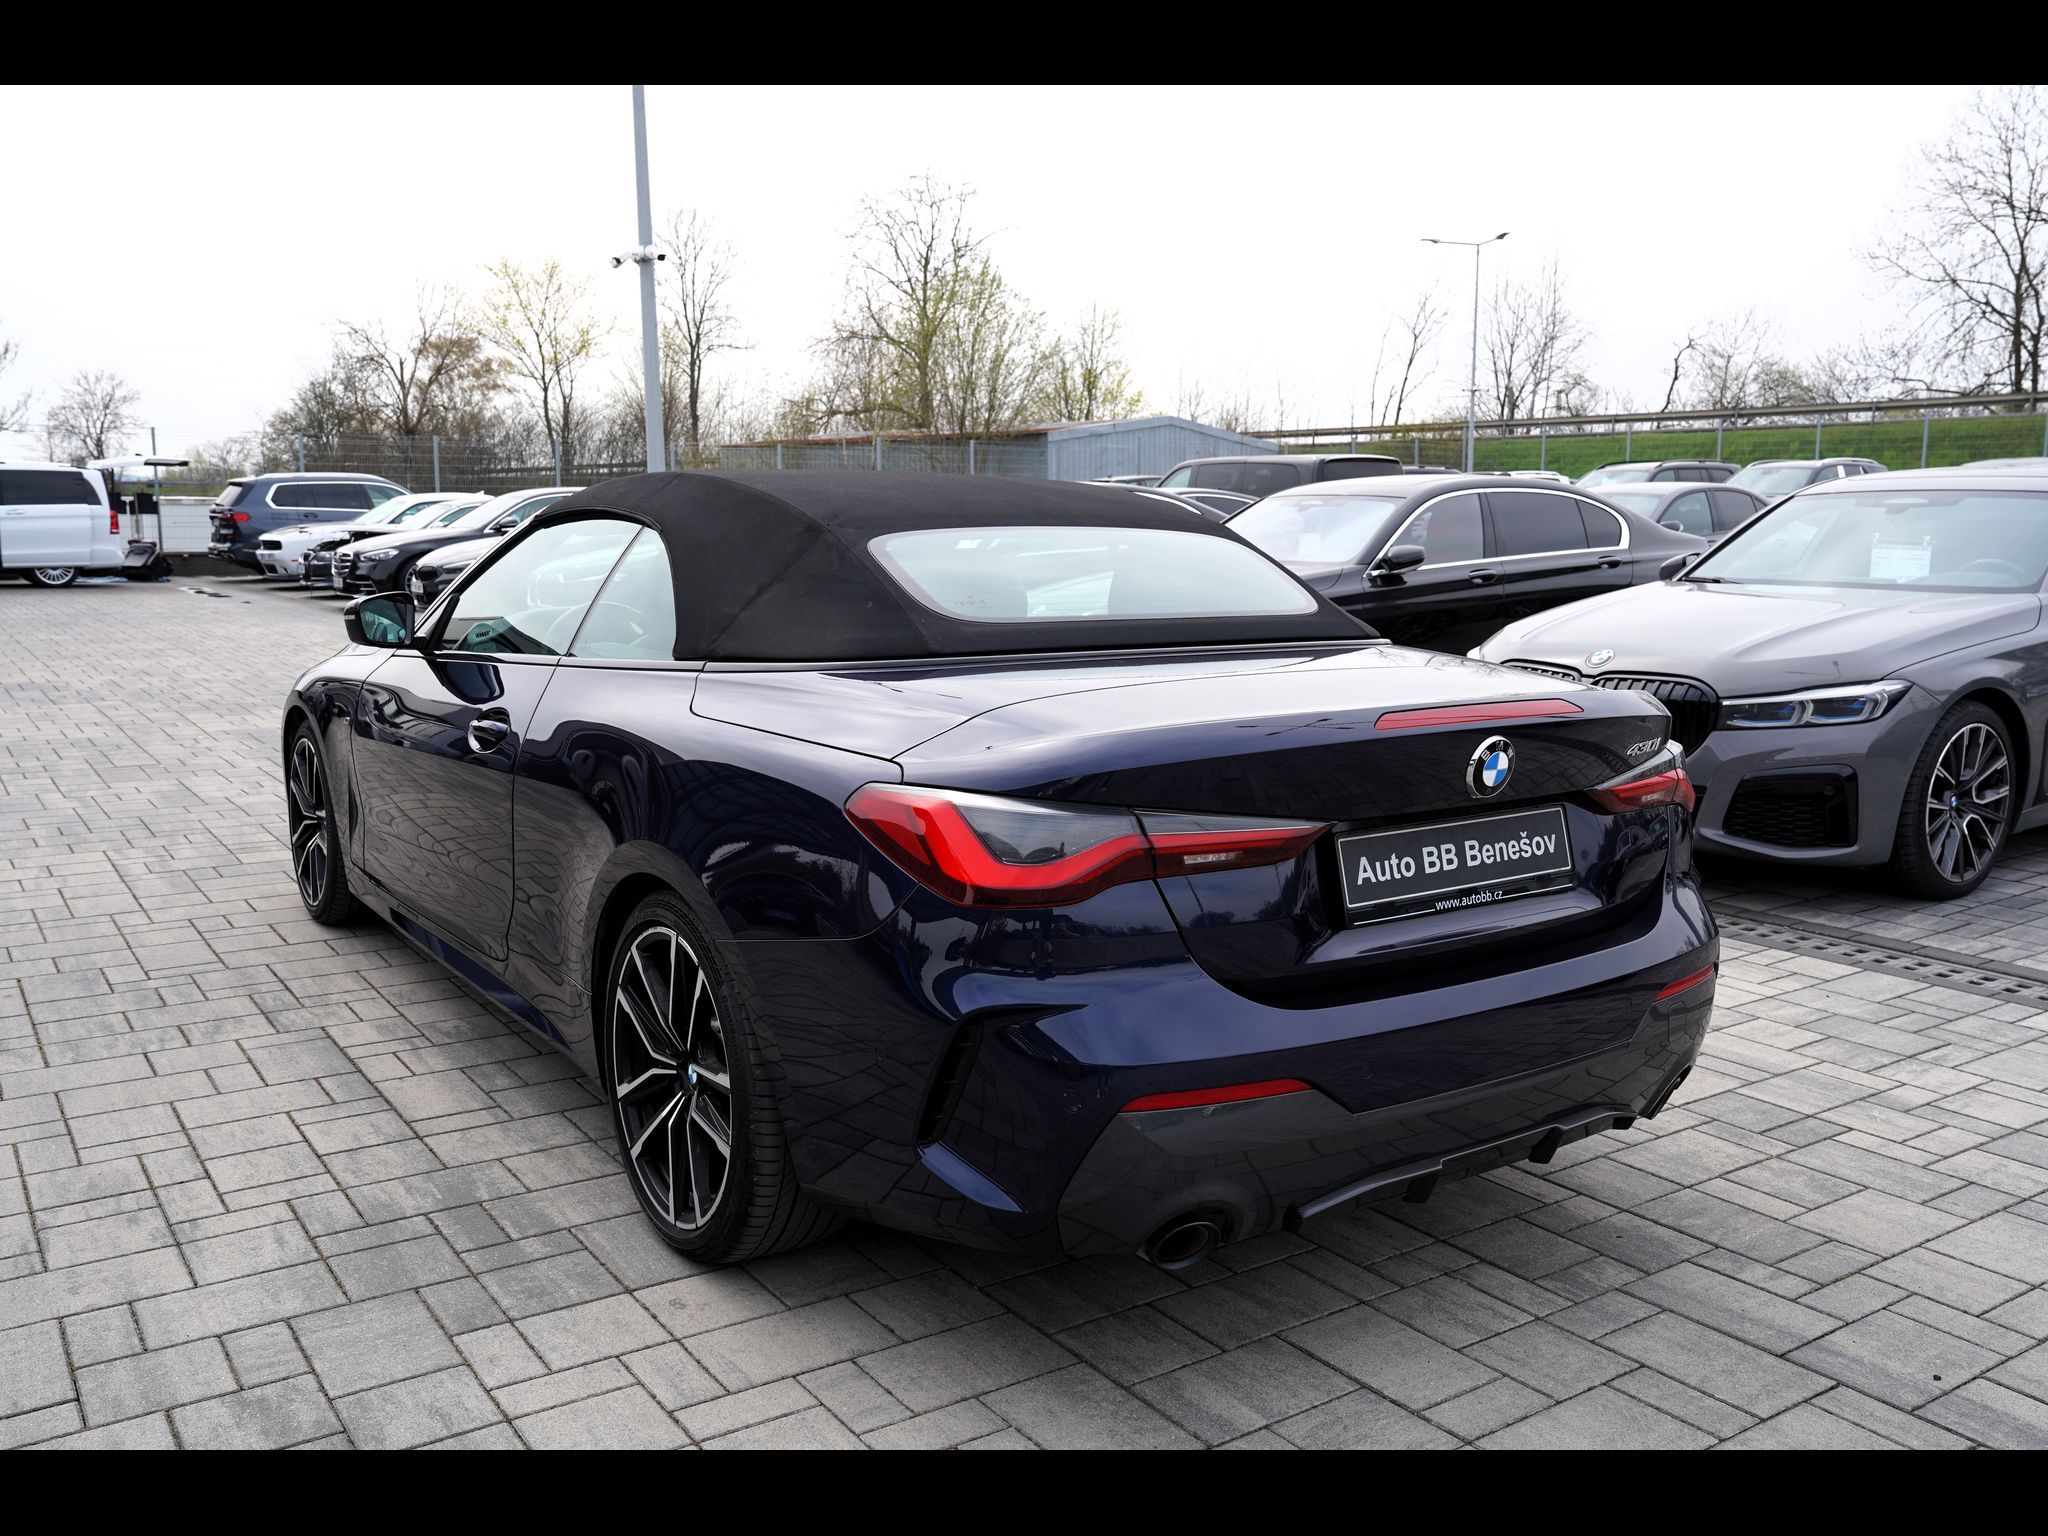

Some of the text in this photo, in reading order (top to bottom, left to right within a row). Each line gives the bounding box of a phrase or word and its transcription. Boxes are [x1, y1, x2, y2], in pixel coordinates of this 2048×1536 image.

[1356, 831, 1557, 886] Auto BB Benešov
[1435, 889, 1504, 911] www.autobb.cz
